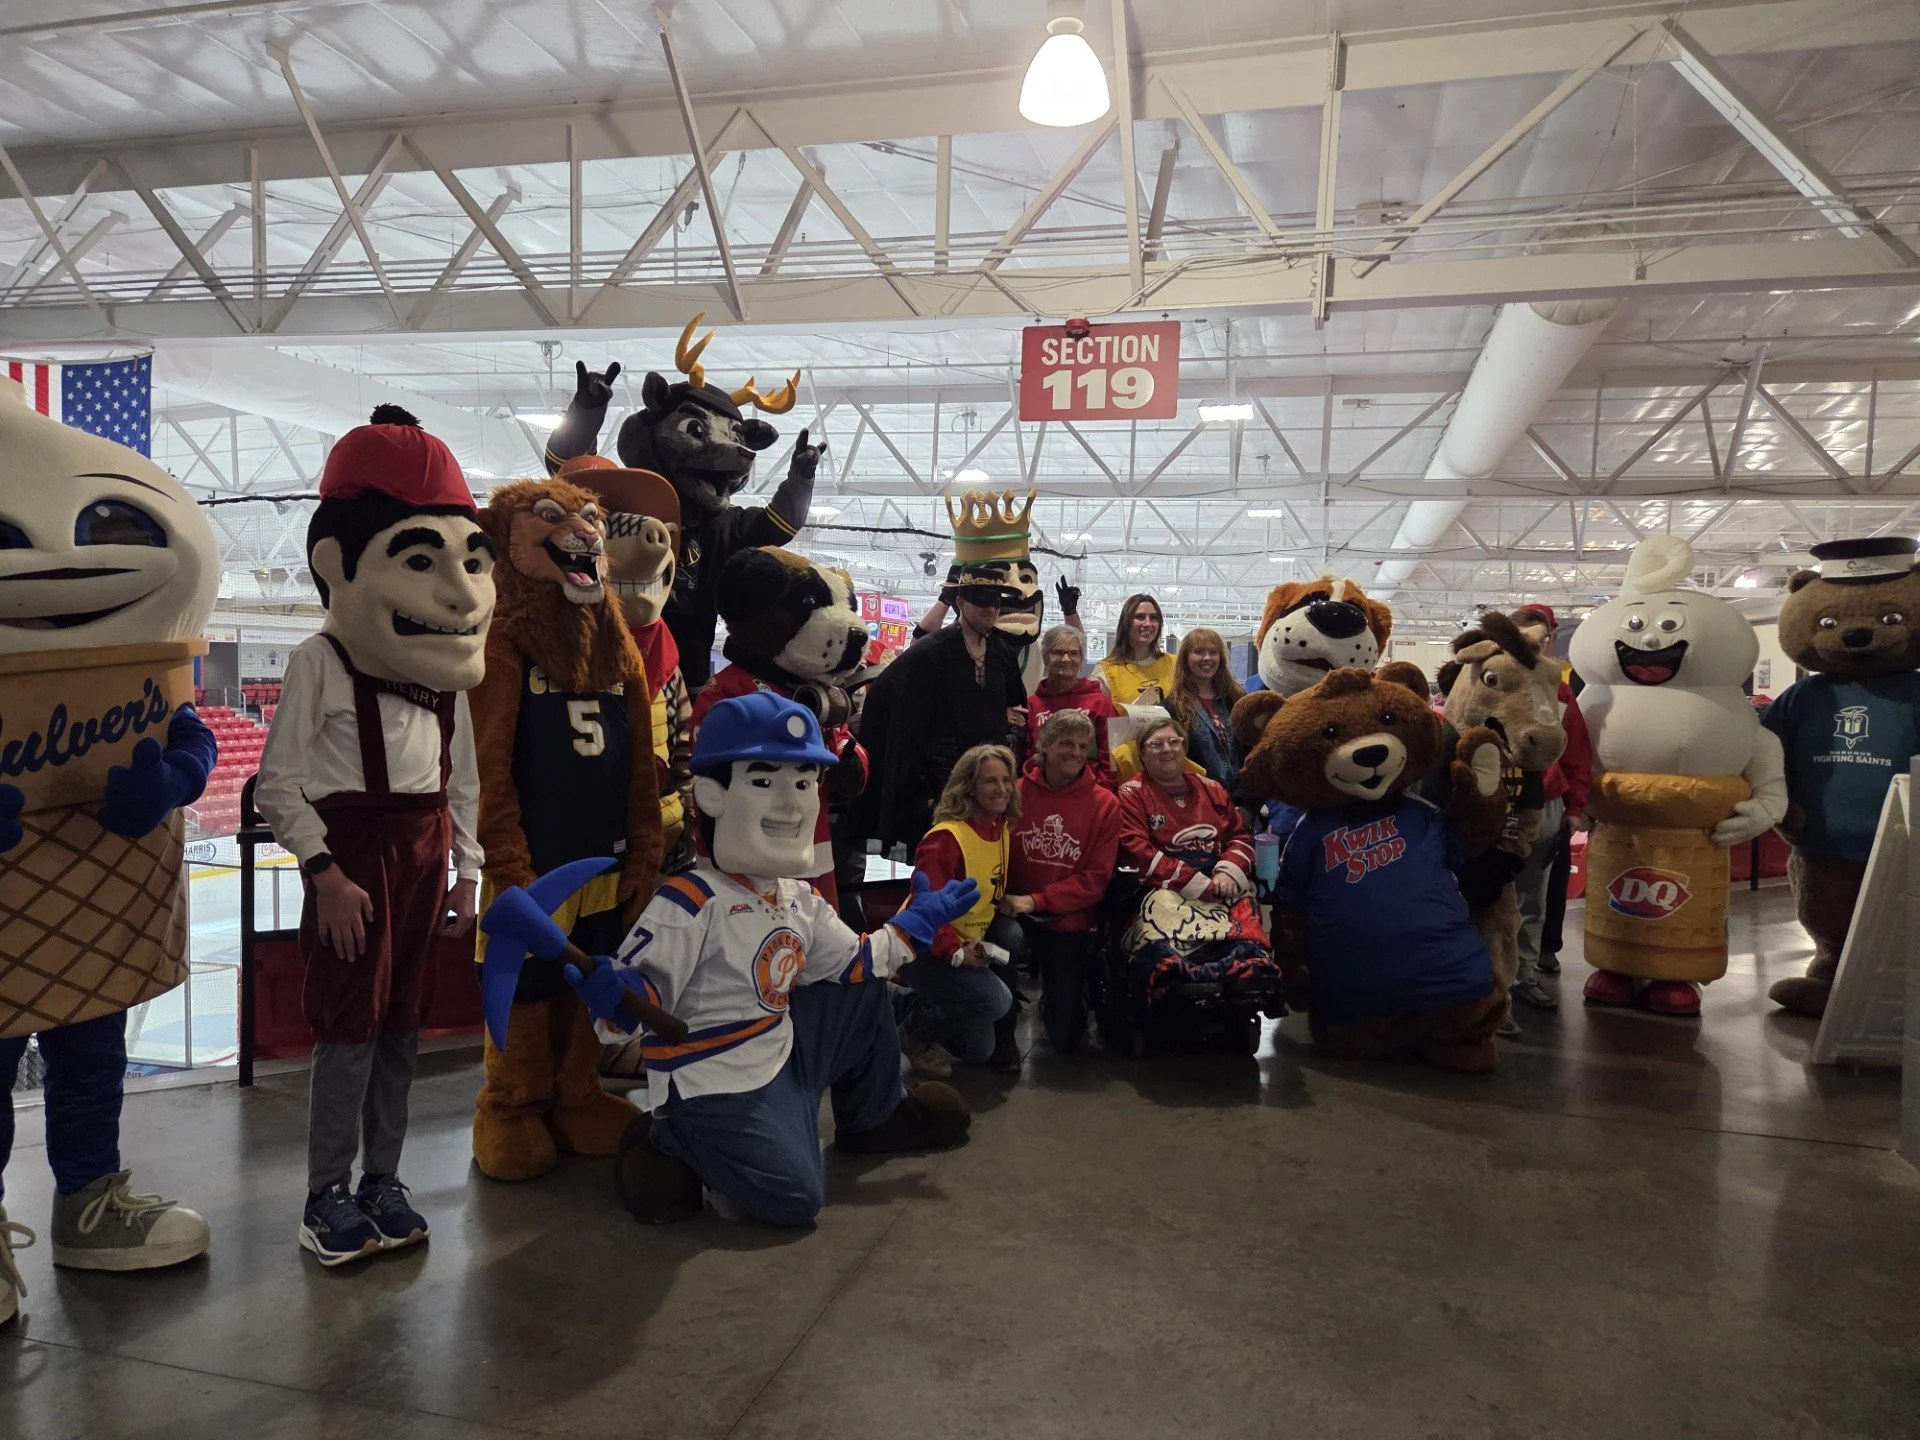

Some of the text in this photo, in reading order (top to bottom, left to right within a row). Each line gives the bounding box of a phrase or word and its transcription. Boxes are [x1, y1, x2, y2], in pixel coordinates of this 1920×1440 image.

[1041, 334, 1160, 366] SECTION
[1042, 367, 1155, 410] 119
[0, 677, 169, 777] ulver's
[567, 699, 606, 757] 5
[1813, 754, 1892, 767] FIGHTING SAINTS
[1619, 876, 1679, 911] DQ
